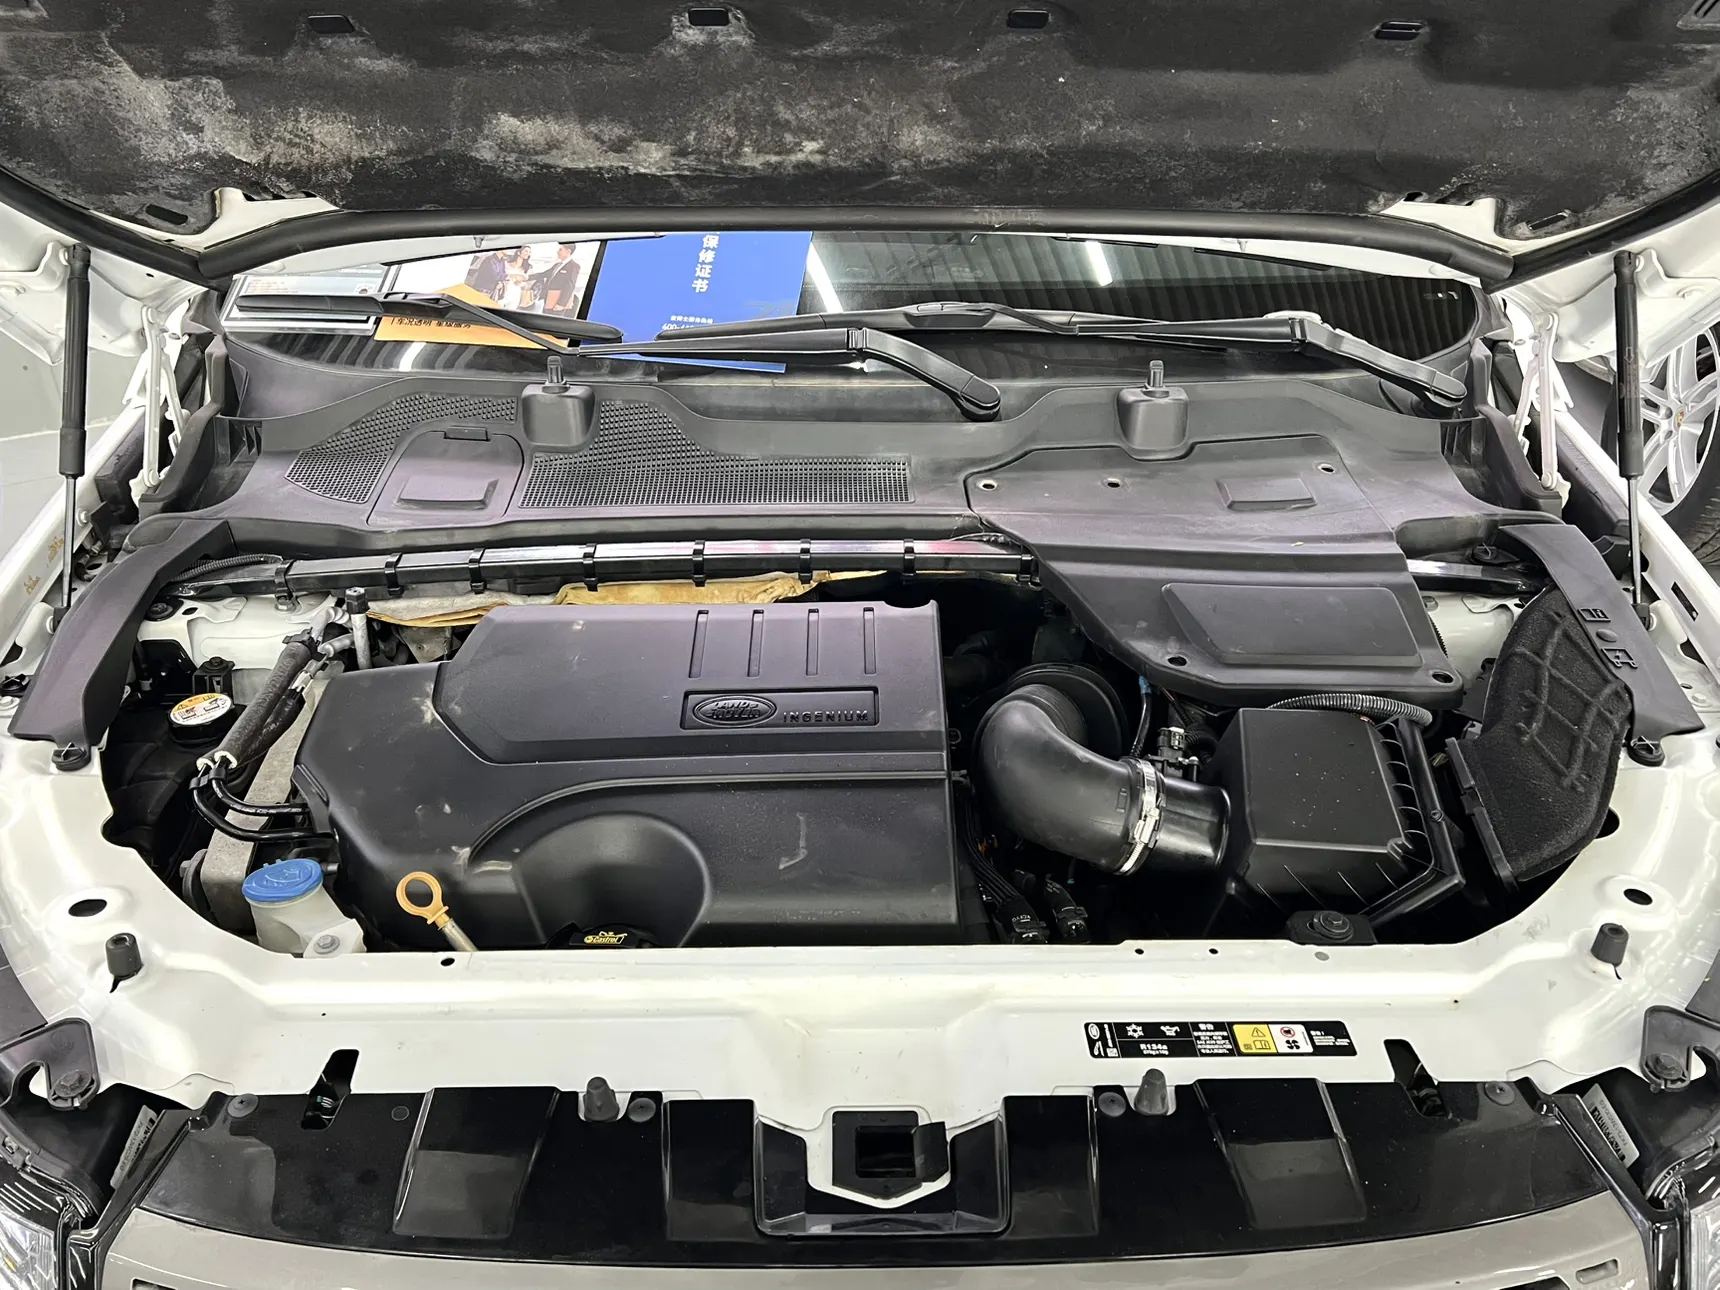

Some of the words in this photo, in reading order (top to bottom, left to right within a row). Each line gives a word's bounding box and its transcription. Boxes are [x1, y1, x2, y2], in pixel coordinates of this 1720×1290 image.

[691, 234, 719, 293] 保修证书
[783, 710, 868, 723] INGENIUM
[592, 935, 618, 945] Castrol
